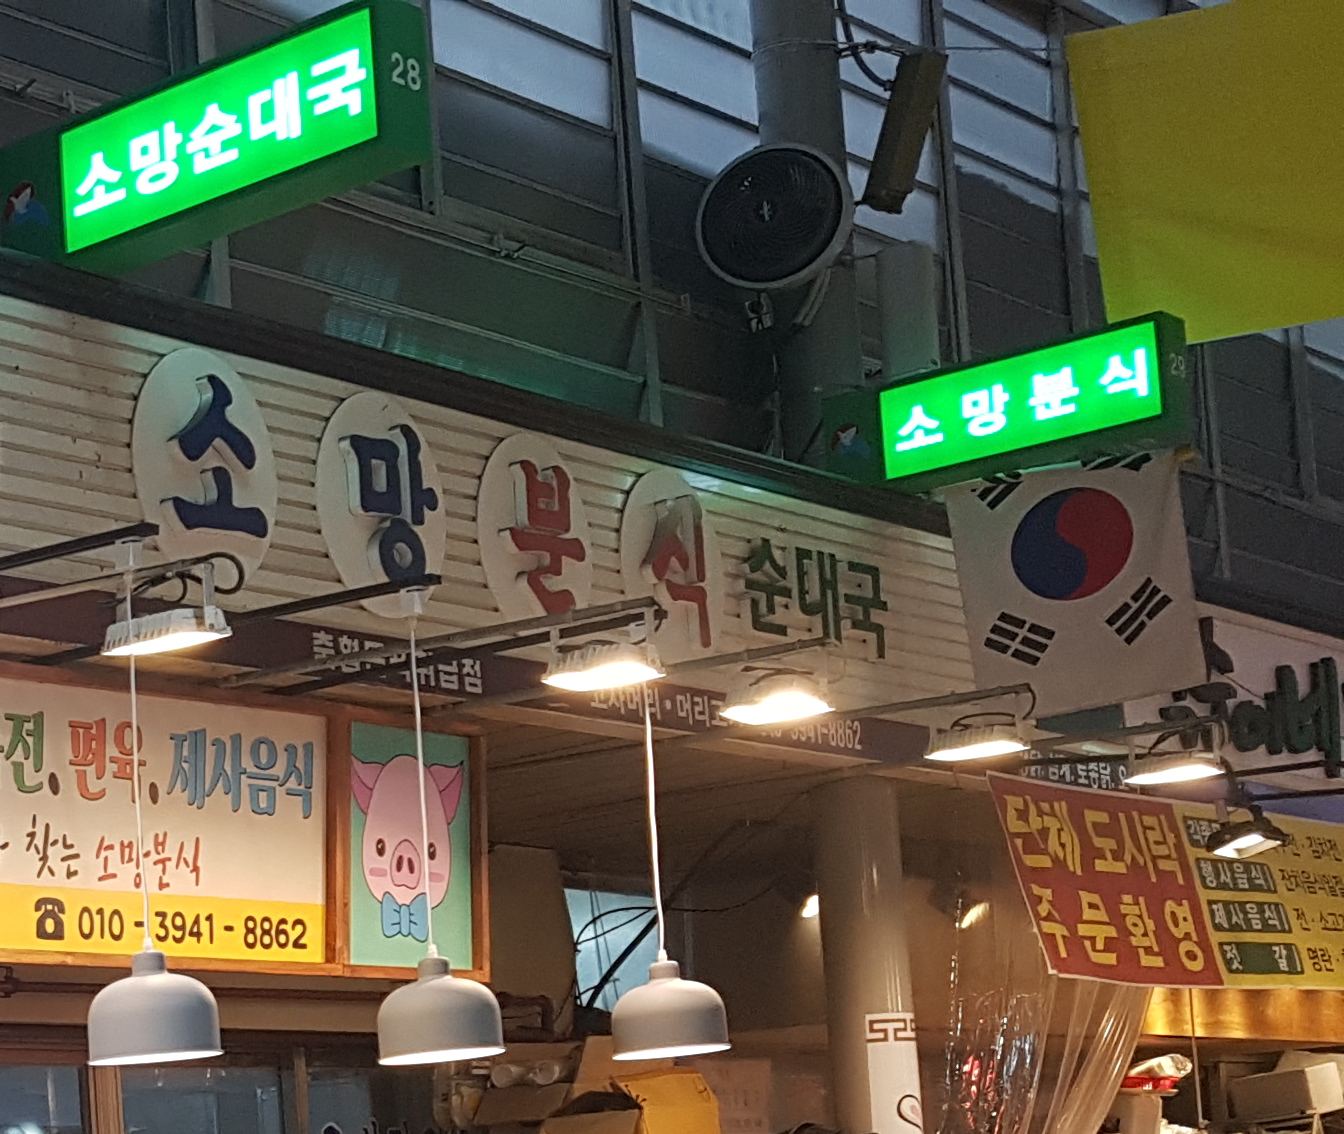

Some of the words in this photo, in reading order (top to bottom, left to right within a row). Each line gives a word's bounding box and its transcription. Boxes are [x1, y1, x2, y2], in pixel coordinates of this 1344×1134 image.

[391, 51, 421, 91] 28
[71, 47, 367, 218] 소망순대국
[1169, 353, 1186, 378] 29
[745, 537, 890, 660] 순대국
[166, 727, 313, 819] 제사음식
[25, 813, 80, 879] 찾는
[95, 831, 203, 891] 소망분식
[1004, 794, 1082, 876] 단체
[1083, 808, 1185, 886] 도시락
[1200, 860, 1268, 890] 행사음식
[1212, 901, 1282, 931] 제사음식
